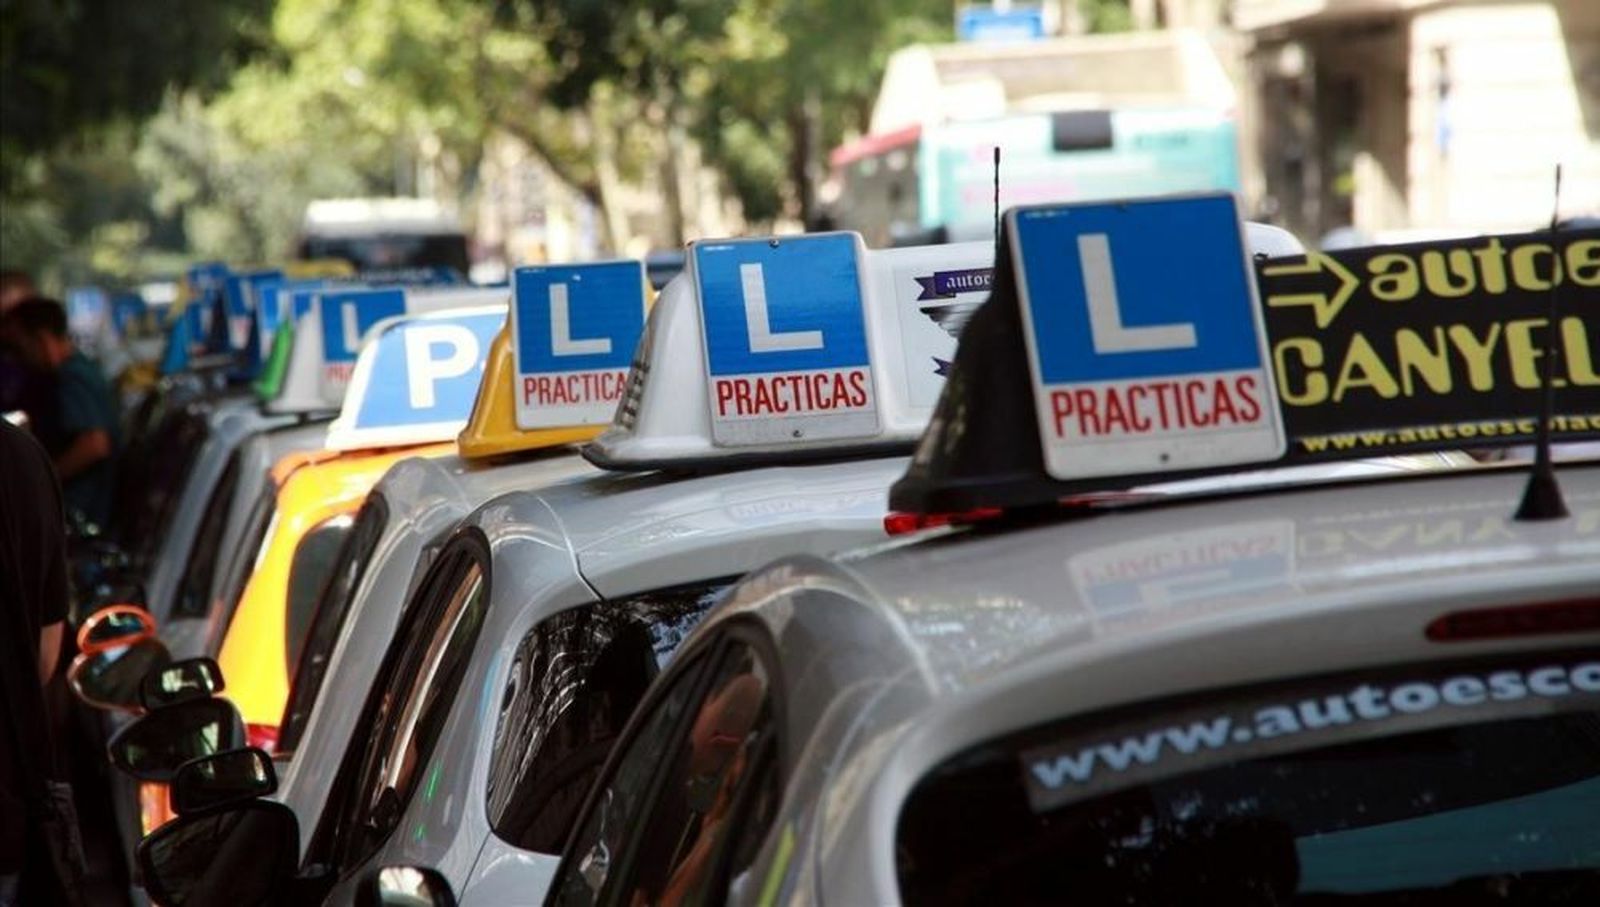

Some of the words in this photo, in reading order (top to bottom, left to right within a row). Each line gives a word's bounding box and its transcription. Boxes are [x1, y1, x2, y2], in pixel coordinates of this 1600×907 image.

[548, 282, 612, 357] L
[739, 262, 824, 353] L
[1077, 233, 1198, 354] L
[716, 371, 867, 417] PRACTICAS
[1274, 317, 1600, 406] CANYEL
[1049, 376, 1261, 438] PRACTICAS
[1034, 663, 1600, 788] www.autoesco
